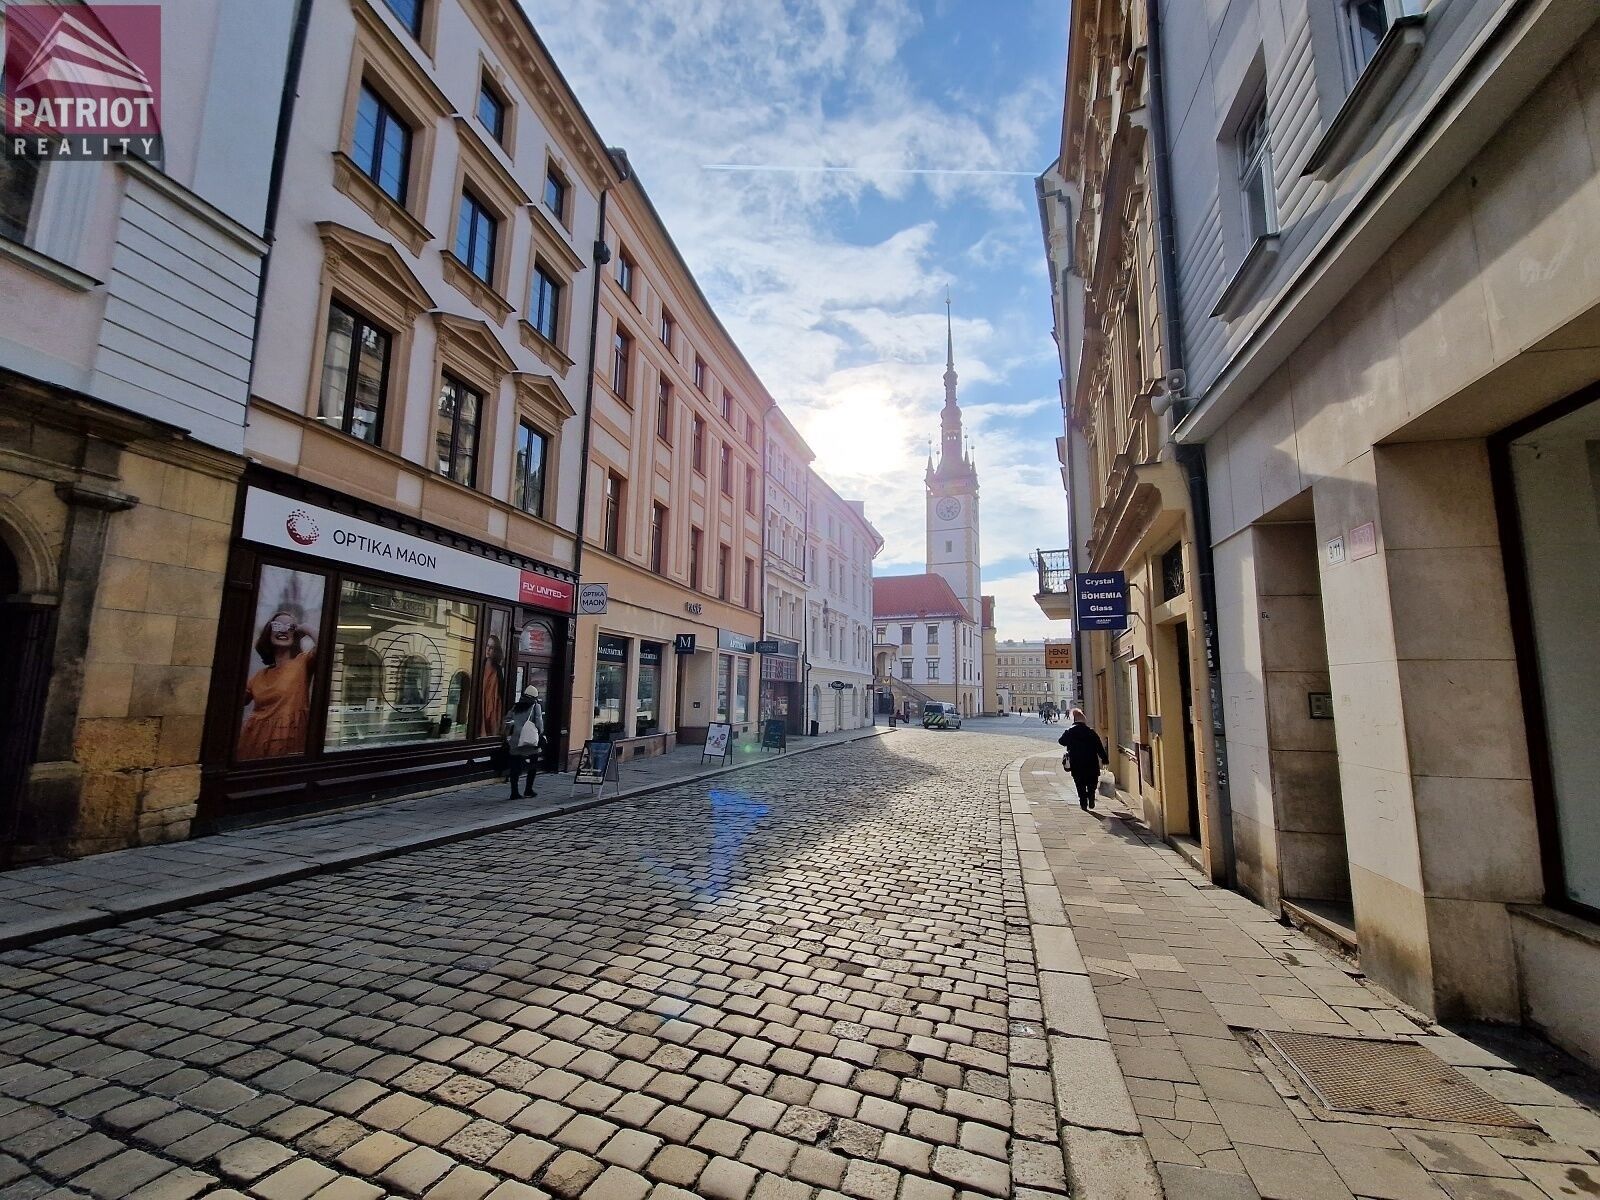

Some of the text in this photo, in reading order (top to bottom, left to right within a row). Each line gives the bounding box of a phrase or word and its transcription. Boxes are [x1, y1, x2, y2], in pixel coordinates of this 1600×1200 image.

[333, 529, 436, 569] OPTIKA MAON
[1085, 578, 1114, 586] Crystal
[522, 581, 535, 592] FLY
[536, 585, 562, 599] UNITED
[1081, 591, 1122, 600] BOHEMIA
[680, 636, 691, 648] M
